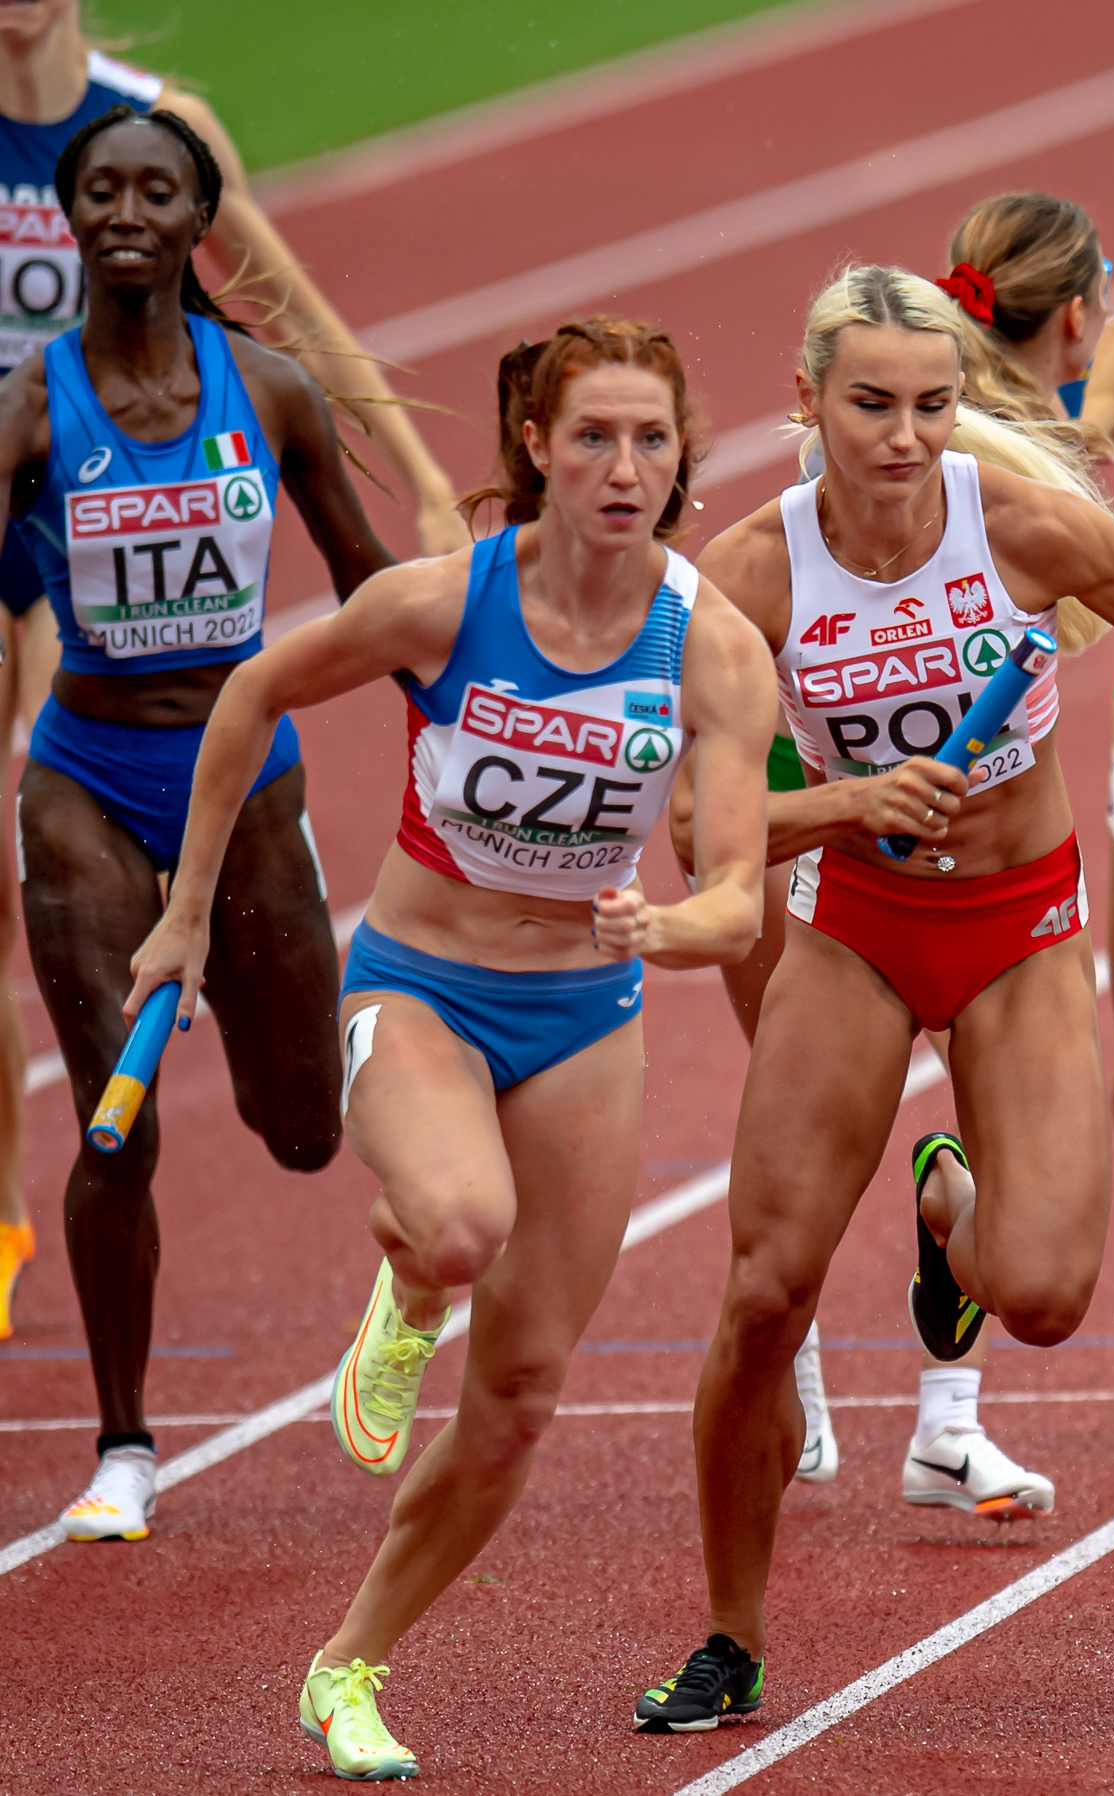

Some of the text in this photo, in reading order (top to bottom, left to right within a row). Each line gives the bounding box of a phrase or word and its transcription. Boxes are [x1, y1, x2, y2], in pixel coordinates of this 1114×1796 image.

[75, 490, 216, 533] SPAR
[112, 535, 240, 606] ITA
[130, 601, 170, 618] RUN
[205, 608, 255, 642] 2022
[800, 612, 857, 646] 4F
[873, 623, 930, 644] ORLEN
[803, 645, 957, 703] SPAR
[467, 696, 618, 760] SPAR
[980, 748, 1023, 784] 022
[463, 755, 643, 836] CZE
[441, 819, 624, 870] MUNICH 2022
[492, 822, 532, 842] RUN
[1030, 892, 1077, 938] 4F
